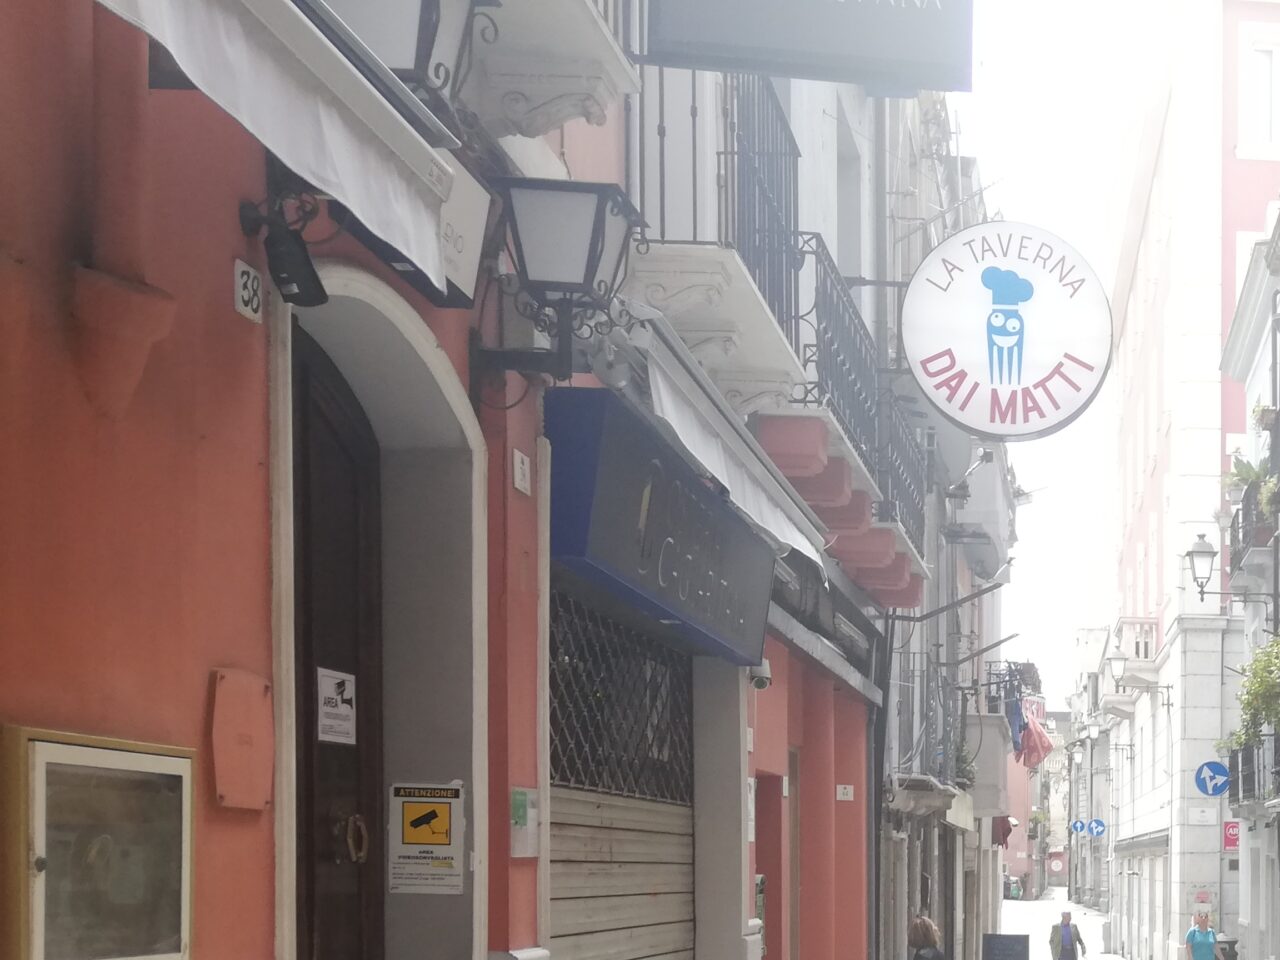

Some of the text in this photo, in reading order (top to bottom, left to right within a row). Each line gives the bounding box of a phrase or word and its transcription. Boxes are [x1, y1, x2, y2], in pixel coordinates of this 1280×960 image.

[240, 270, 260, 314] 38
[926, 233, 1087, 299] LA TAVERNA
[919, 347, 1095, 425] DAI MATTI
[400, 788, 456, 798] ATTENZIONE!
